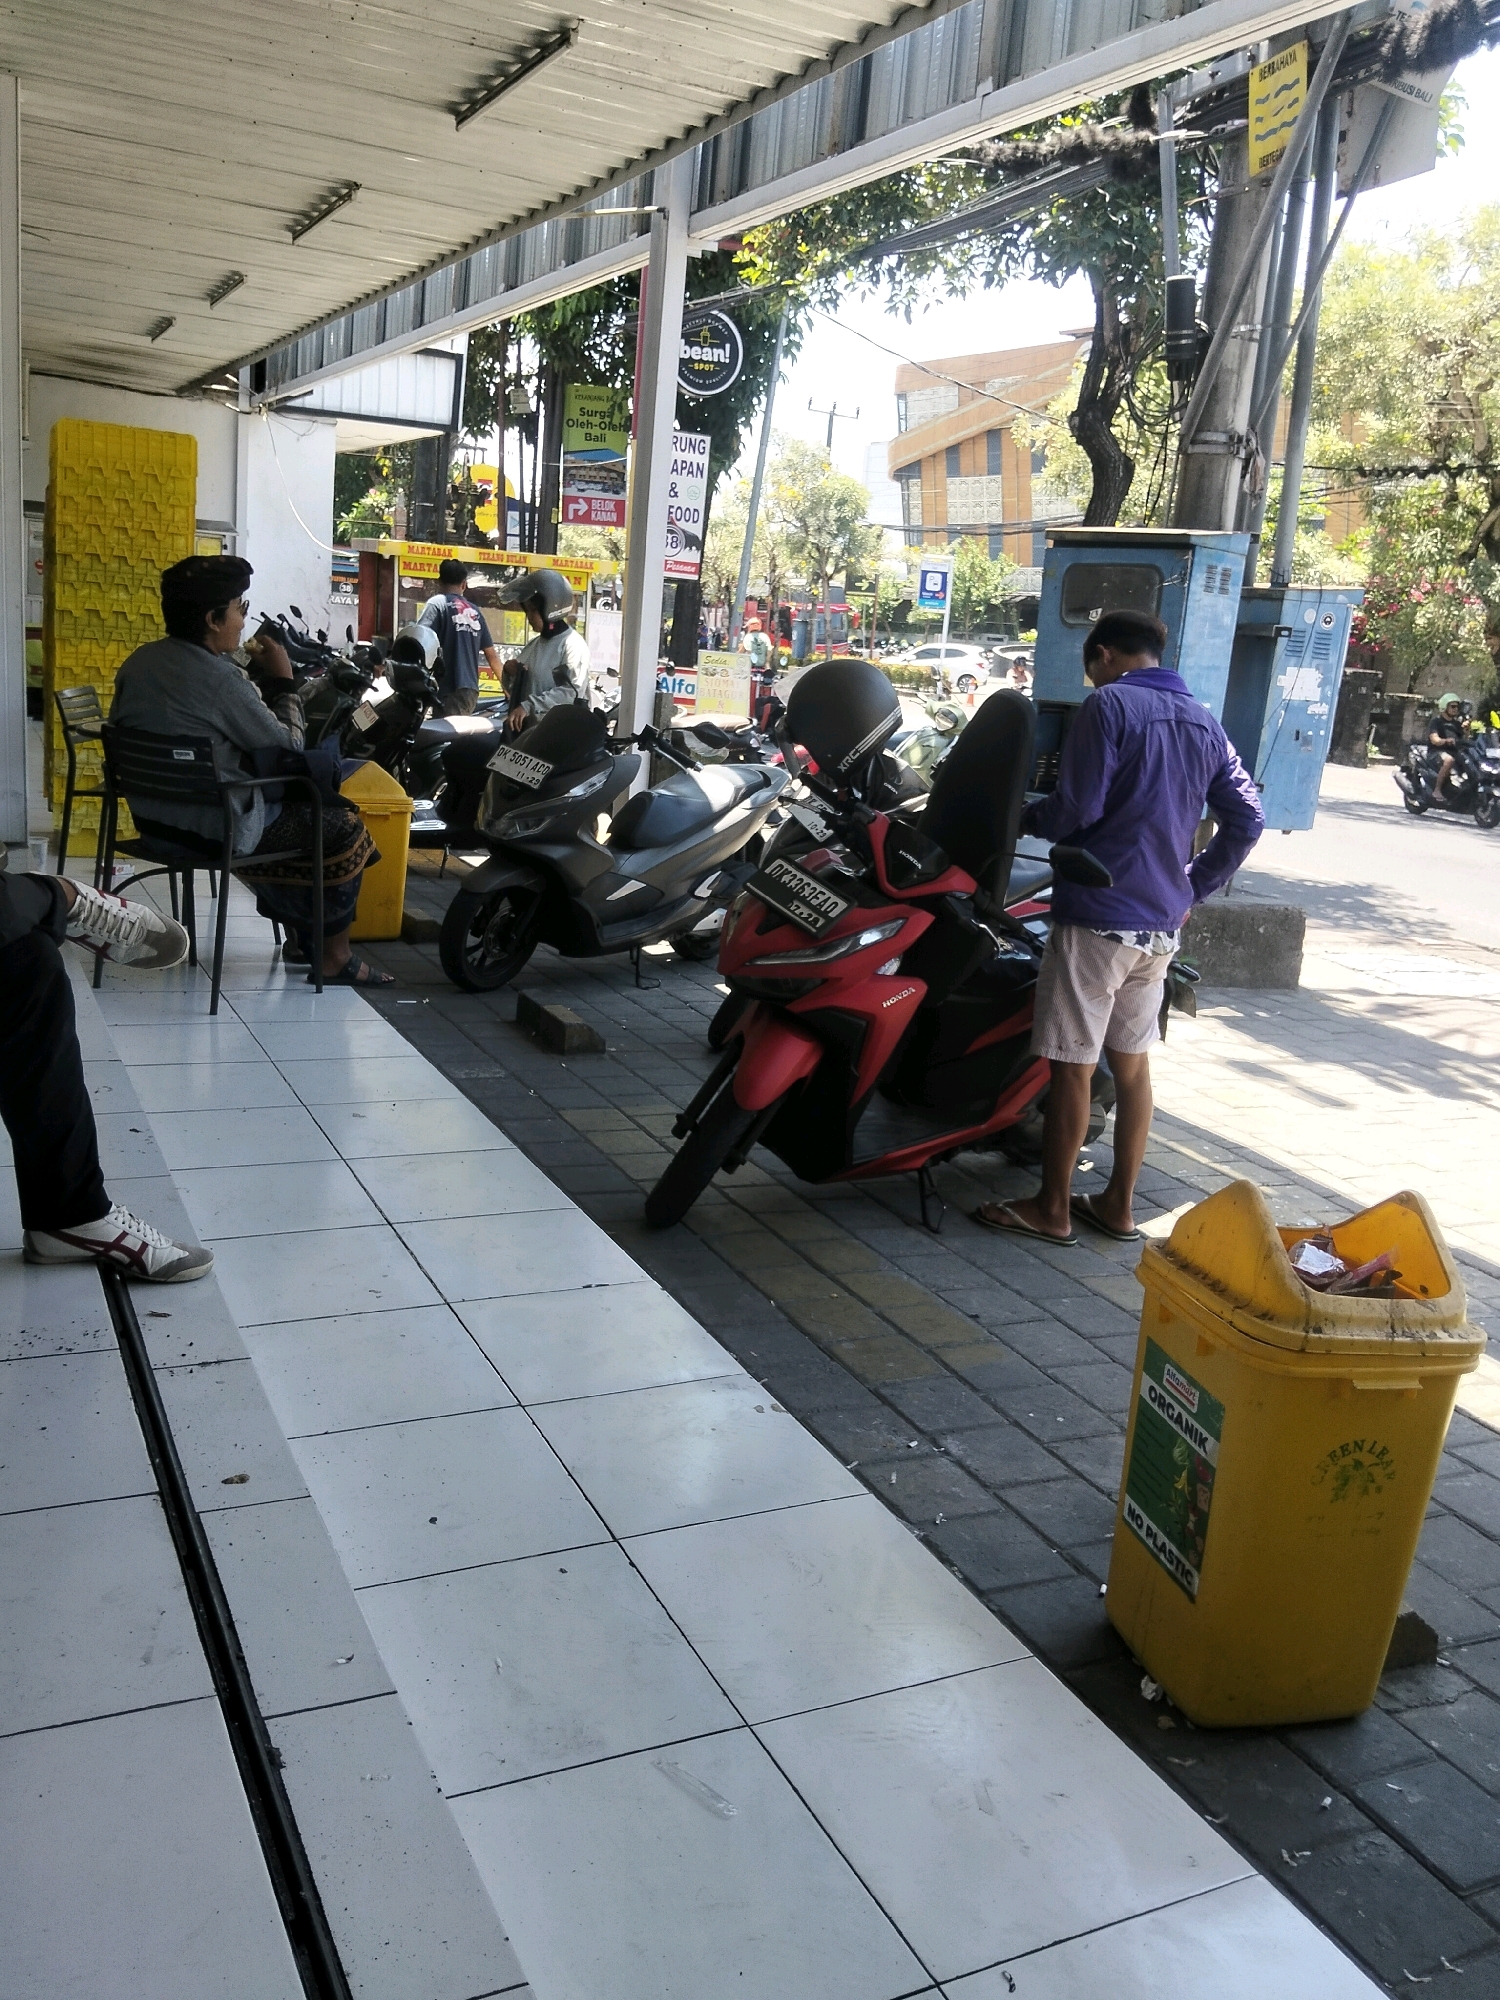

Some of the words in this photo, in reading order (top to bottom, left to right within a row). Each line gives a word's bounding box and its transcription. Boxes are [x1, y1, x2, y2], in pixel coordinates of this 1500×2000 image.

[1258, 48, 1298, 82] BERBAHAYA
[1414, 88, 1434, 104] BALI
[680, 338, 730, 364] bean!
[693, 362, 716, 372] SPOT
[565, 418, 625, 432] Oleh-Oleh
[584, 432, 606, 443] Bali
[672, 435, 706, 456] RUNG
[670, 458, 704, 479] APAN
[668, 482, 679, 498] &
[590, 499, 616, 511] BELOK
[667, 505, 700, 524] FOOD
[590, 510, 617, 522] KANAN
[402, 561, 440, 574] MARTA
[407, 544, 453, 559] MARTABAK
[478, 551, 504, 563] TERANG
[552, 558, 594, 571] MARTABAK
[497, 747, 511, 760] DK
[509, 751, 533, 769] 5051
[899, 850, 922, 870] HONDA
[881, 987, 916, 1008] HONDA
[1166, 1367, 1197, 1400] Alfamart
[1147, 1384, 1209, 1455] ORGANIK
[1127, 1502, 1144, 1530] NO
[1145, 1523, 1194, 1587] PLASTIC
